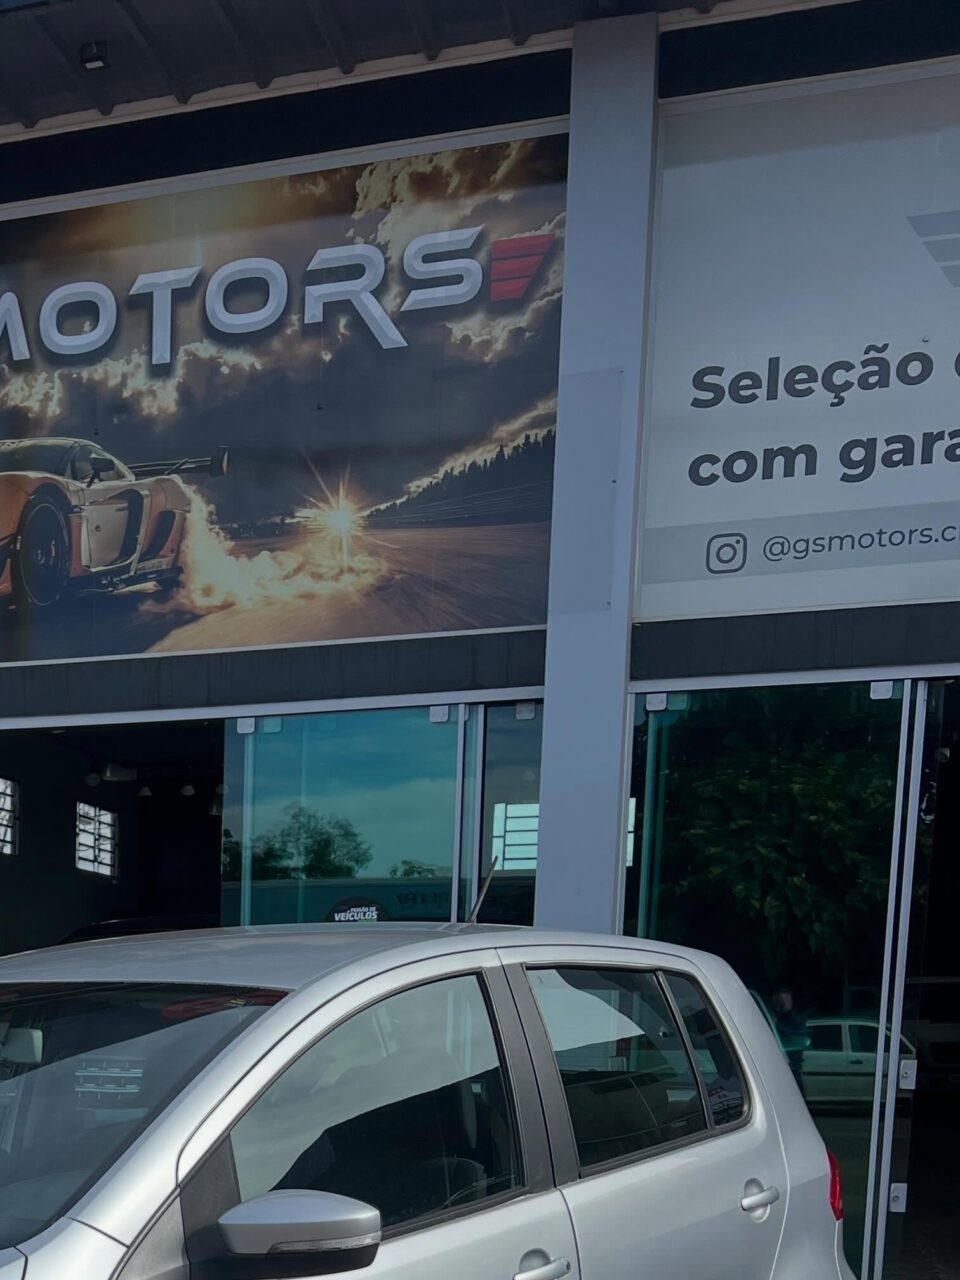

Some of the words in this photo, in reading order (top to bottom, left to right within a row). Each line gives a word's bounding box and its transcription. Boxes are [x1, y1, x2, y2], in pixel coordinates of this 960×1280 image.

[690, 343, 934, 409] Seleção
[688, 442, 818, 487] com
[763, 525, 960, 562] @gsmotors.c
[334, 910, 378, 921] VEÍCULOS
